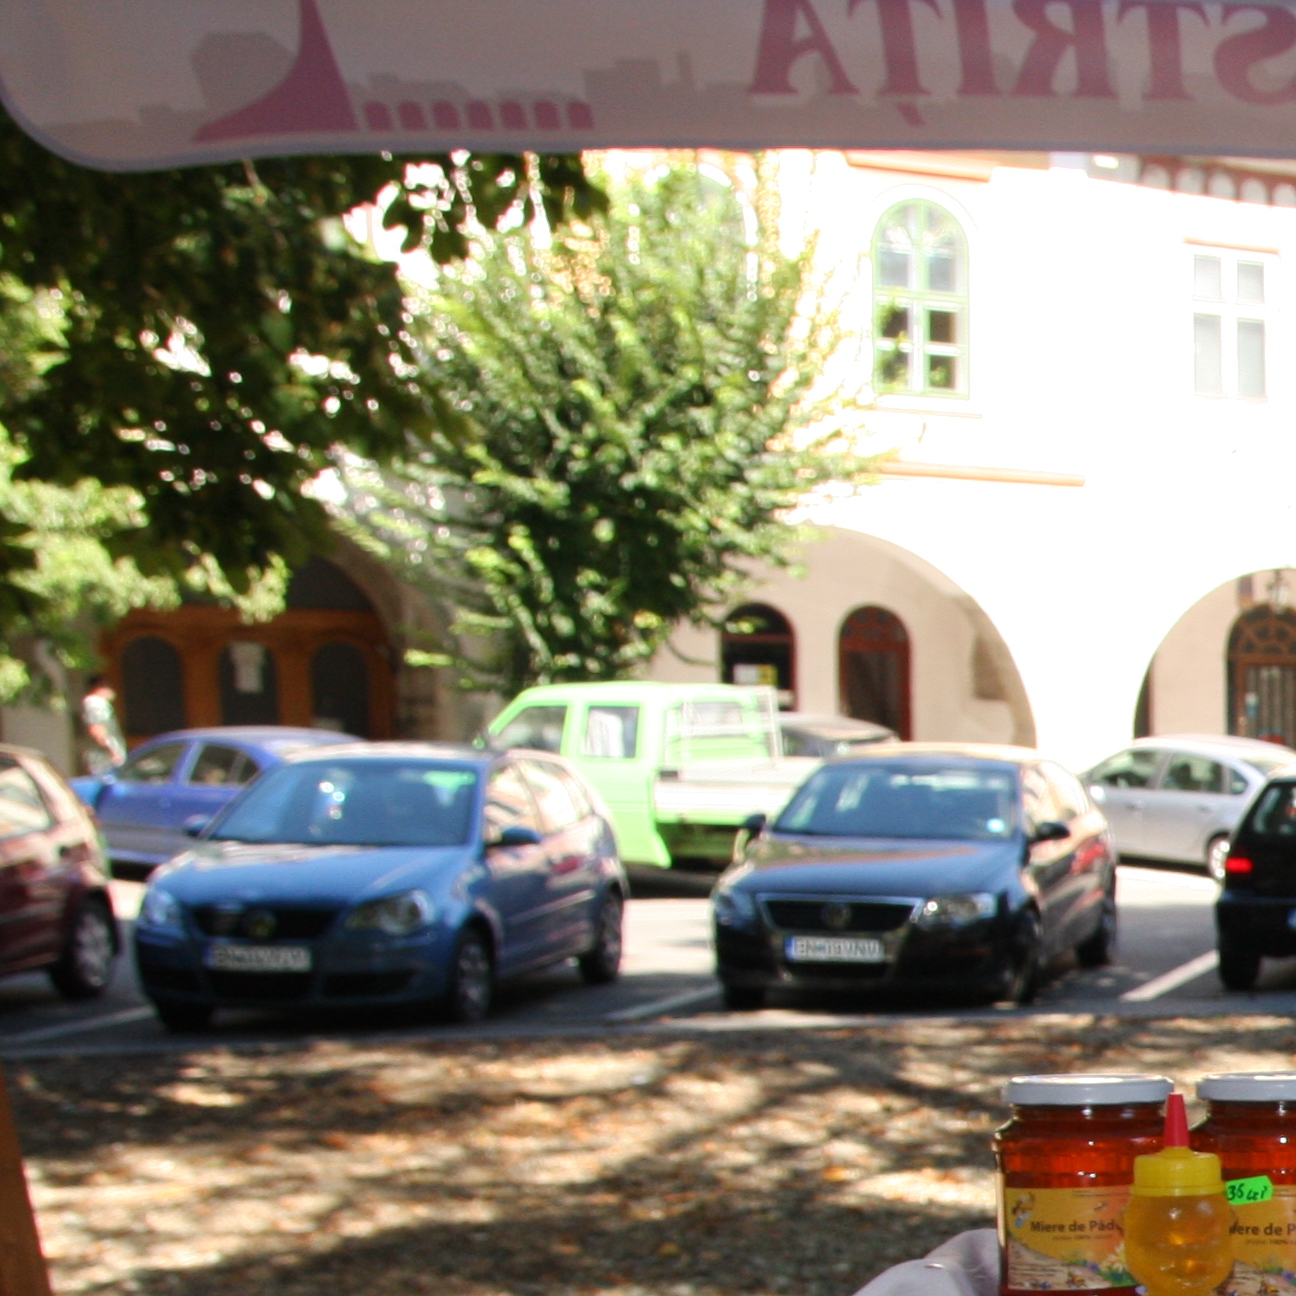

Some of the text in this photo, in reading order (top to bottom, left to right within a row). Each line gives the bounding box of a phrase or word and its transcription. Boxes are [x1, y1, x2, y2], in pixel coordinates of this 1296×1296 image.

[1030, 1220, 1065, 1232] Miere
[1069, 1220, 1085, 1232] de
[1264, 1222, 1282, 1235] de
